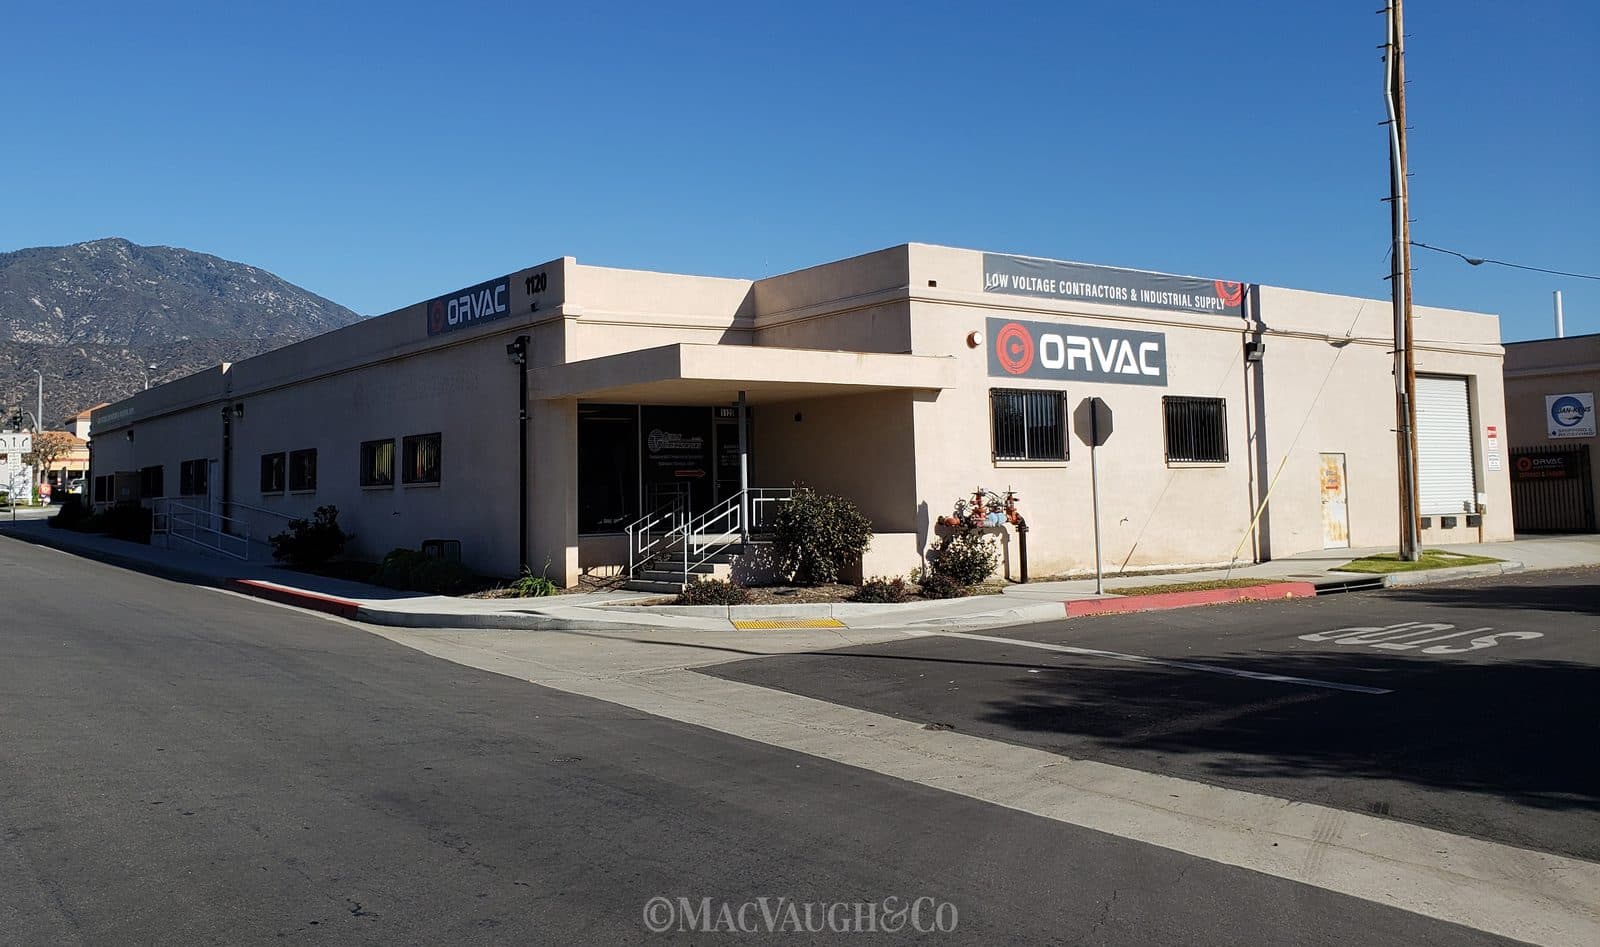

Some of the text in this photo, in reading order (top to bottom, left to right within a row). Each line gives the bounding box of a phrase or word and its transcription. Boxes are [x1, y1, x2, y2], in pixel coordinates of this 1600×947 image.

[525, 271, 548, 297] 1120
[984, 272, 1226, 310] LOW VOLTAGE CONTRACTORS & INDUSTRIAL SUPPLY
[447, 284, 506, 326] ORVAC
[1039, 333, 1161, 377] ORVAC
